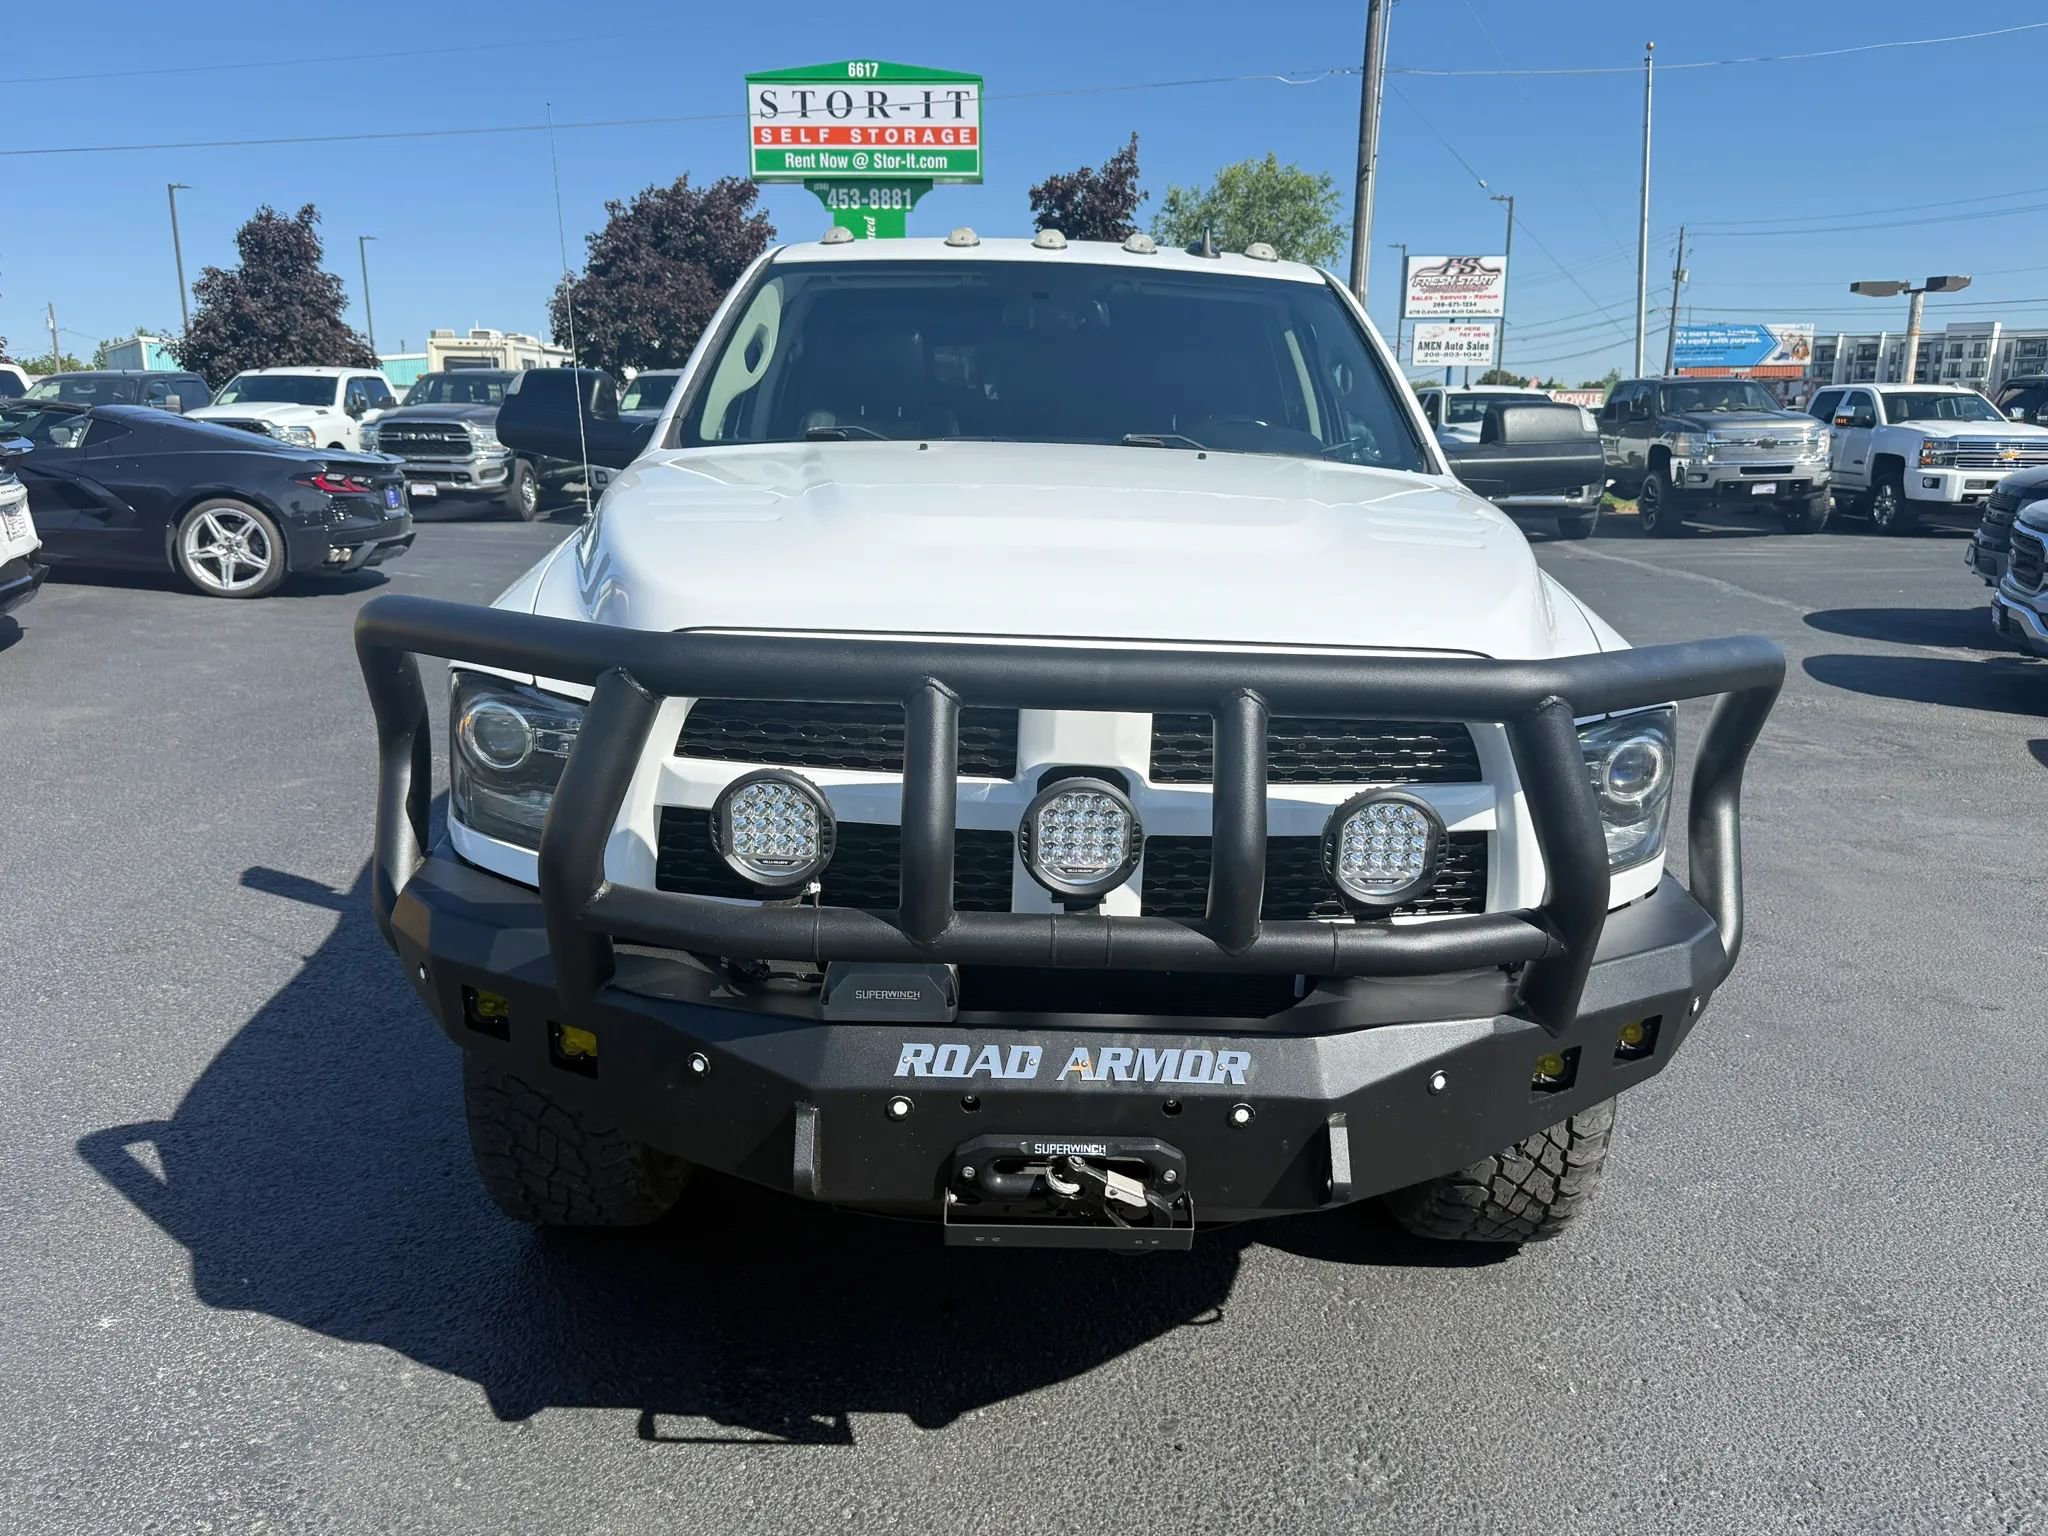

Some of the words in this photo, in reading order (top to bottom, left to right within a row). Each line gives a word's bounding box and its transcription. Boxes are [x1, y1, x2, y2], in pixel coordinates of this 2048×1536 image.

[848, 62, 878, 78] 6617
[759, 90, 970, 119] STOR-IT
[761, 128, 830, 143] SELF
[850, 128, 971, 143] STORAGE
[785, 153, 816, 168] Rent
[820, 153, 848, 168] Now
[852, 152, 868, 169] @
[873, 152, 948, 169] Stor-It.com
[827, 188, 912, 209] 453-8881
[1412, 275, 1456, 287] FRESH
[1457, 274, 1498, 286] START
[1417, 341, 1442, 351] AMEN
[1444, 341, 1464, 351] Auto
[1466, 341, 1490, 351] Sales
[1556, 393, 1587, 404] NOW
[402, 432, 443, 441] RAM
[855, 990, 920, 1000] SUPERWINCH
[893, 1043, 1043, 1078] ROAD
[1055, 1047, 1251, 1085] ARMOR
[1034, 1143, 1107, 1156] SUPERWINCH
